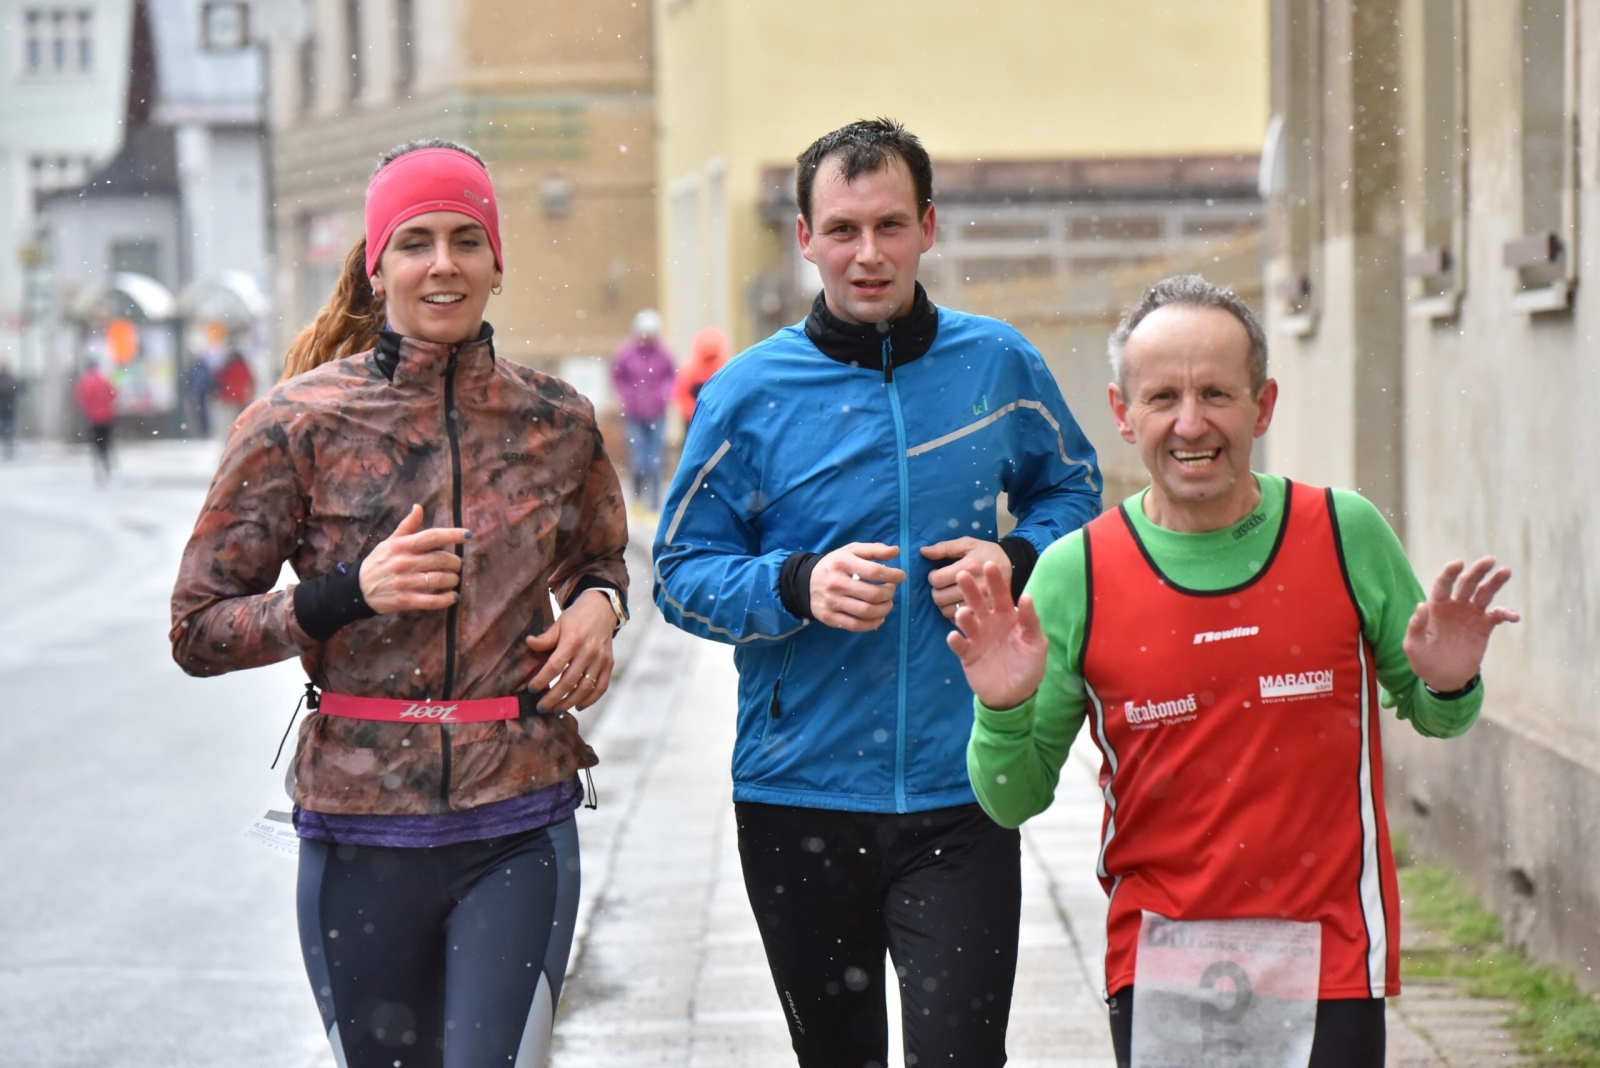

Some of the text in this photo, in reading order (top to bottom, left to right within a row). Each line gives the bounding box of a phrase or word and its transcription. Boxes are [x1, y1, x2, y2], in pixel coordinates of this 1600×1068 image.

[1258, 669, 1333, 688] MARATON
[1124, 693, 1197, 724] Krakonoš
[785, 990, 803, 1026] CRAFT
